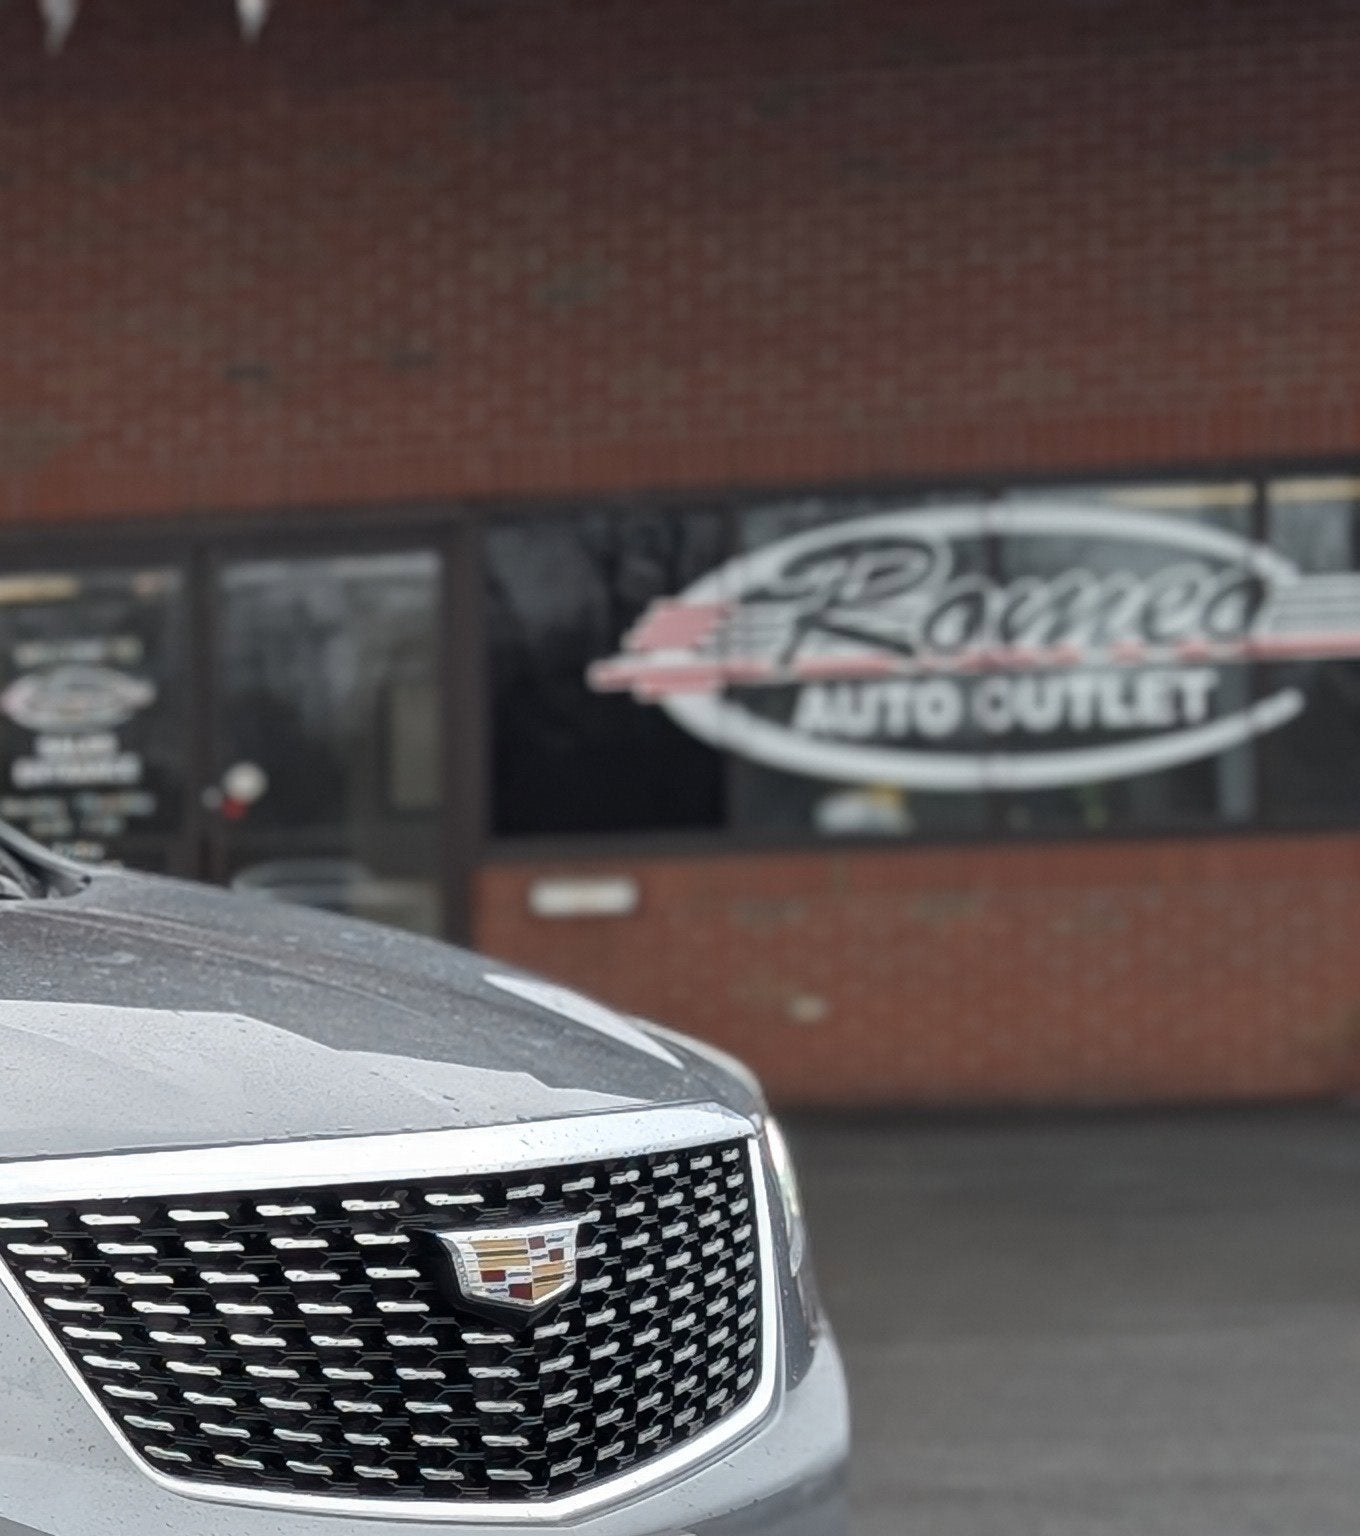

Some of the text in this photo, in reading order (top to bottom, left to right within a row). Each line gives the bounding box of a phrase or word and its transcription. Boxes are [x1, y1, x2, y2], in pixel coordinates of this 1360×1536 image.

[743, 533, 1272, 670] Romeo
[792, 668, 1219, 738] AUTO OUTLET
